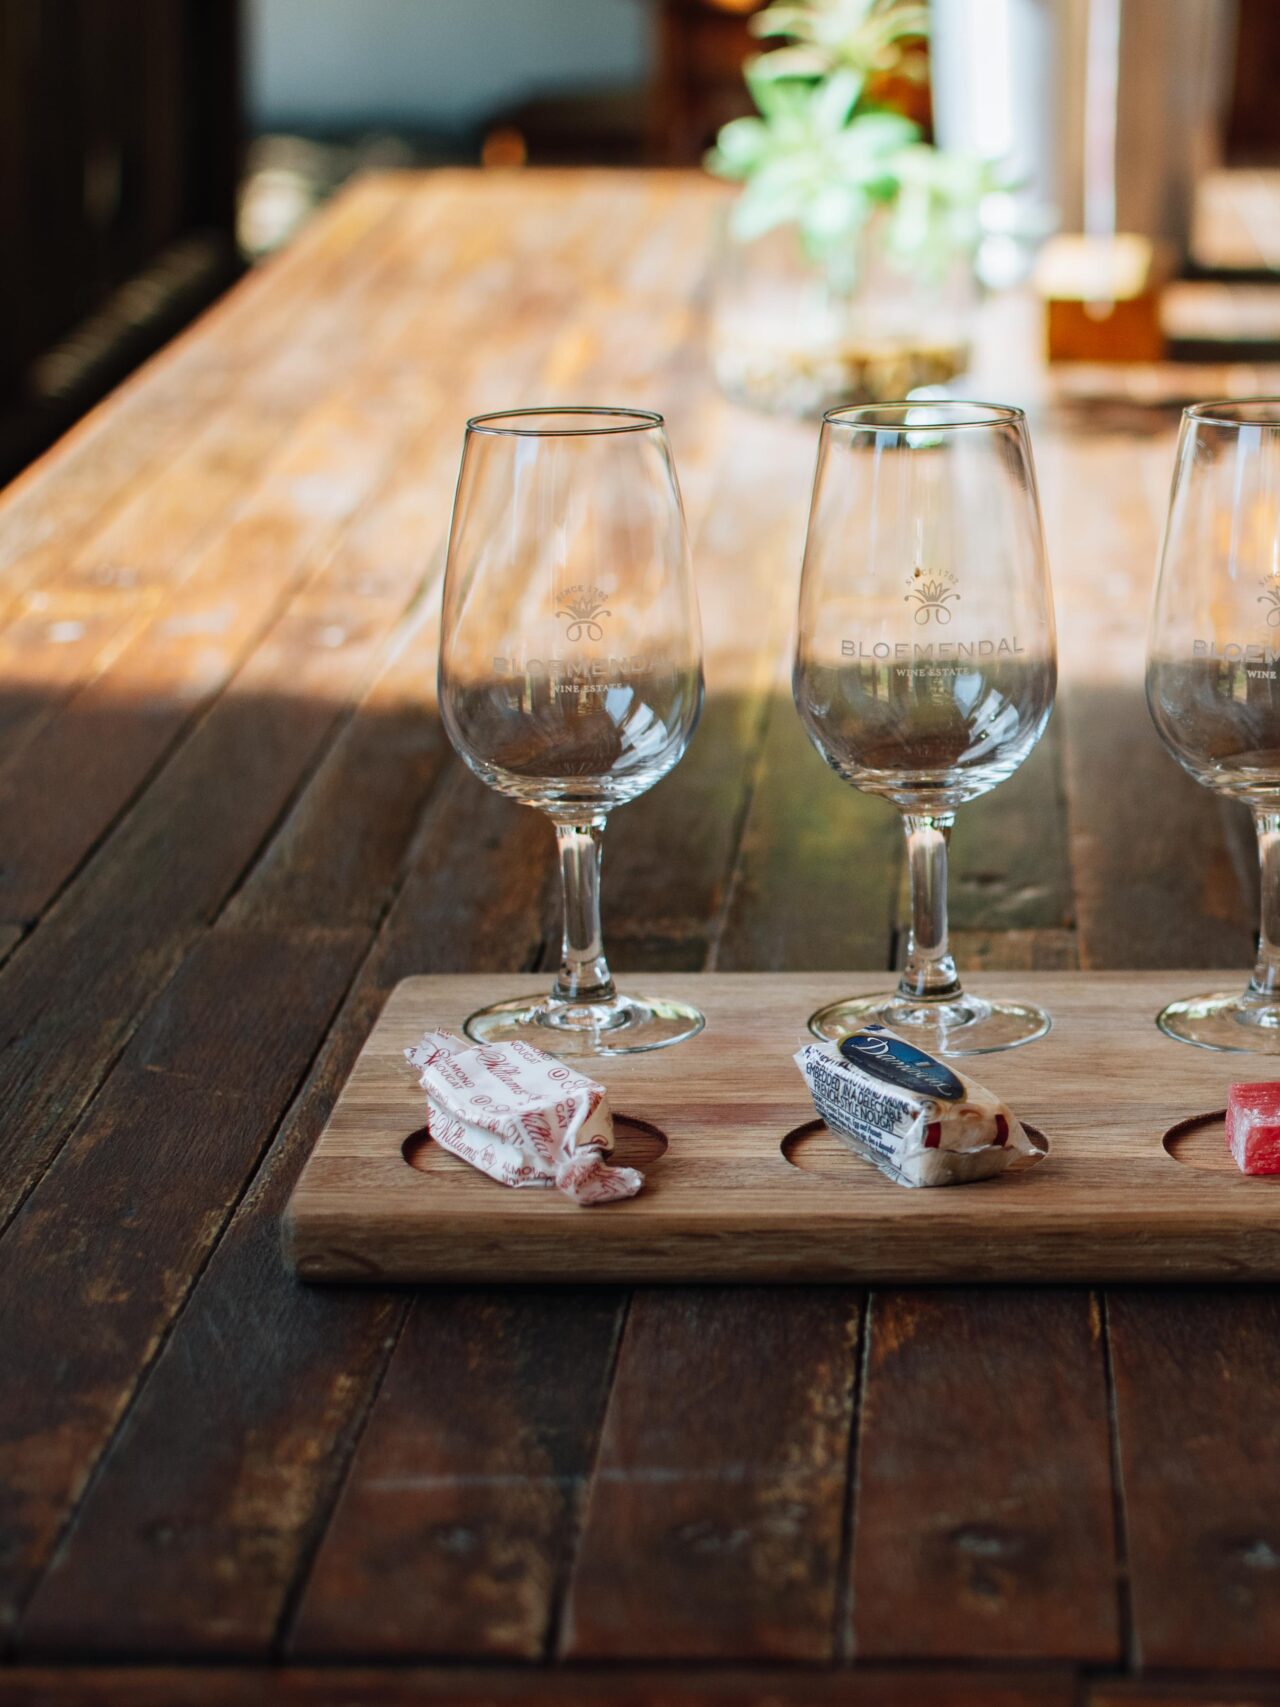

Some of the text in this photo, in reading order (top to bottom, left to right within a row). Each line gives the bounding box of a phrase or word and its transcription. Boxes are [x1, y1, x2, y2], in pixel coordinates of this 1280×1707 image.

[905, 568, 934, 586] SICE
[841, 636, 1025, 660] BLOEMENDAL
[896, 667, 970, 677] WINE ESTATE
[1247, 670, 1277, 679] WINE
[859, 1091, 903, 1124] DELECTABLE
[860, 1104, 895, 1133] NOUGAT
